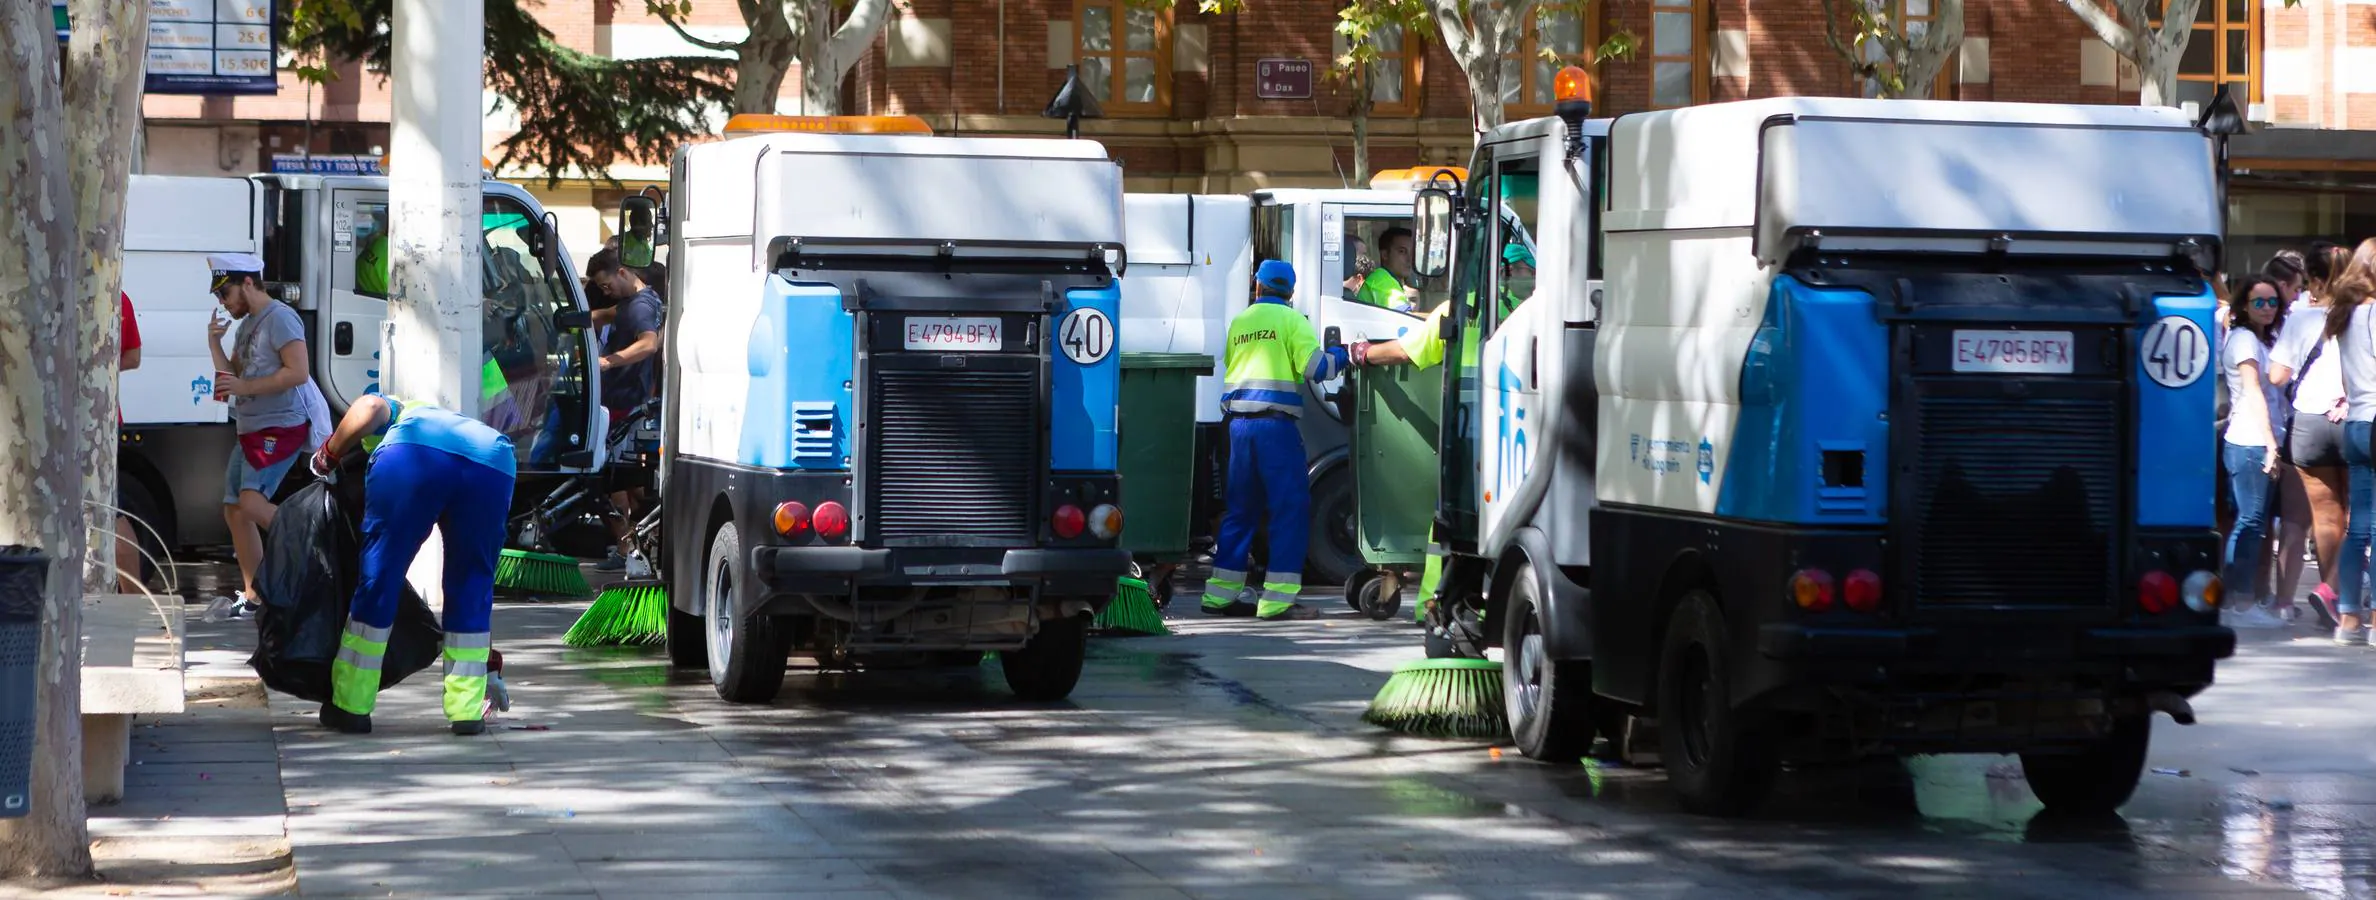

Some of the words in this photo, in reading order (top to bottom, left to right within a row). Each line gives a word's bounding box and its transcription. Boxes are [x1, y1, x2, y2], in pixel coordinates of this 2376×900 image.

[246, 7, 255, 18] 6
[258, 7, 267, 18] €
[238, 31, 255, 43] 25
[258, 32, 267, 43] €
[1278, 63, 1308, 73] Paseo
[1275, 83, 1293, 92] Dax
[275, 160, 323, 172] PERSIAAS
[1065, 313, 1104, 358] 40
[1233, 329, 1277, 347] LIMPIEZA
[2149, 322, 2196, 380] 40
